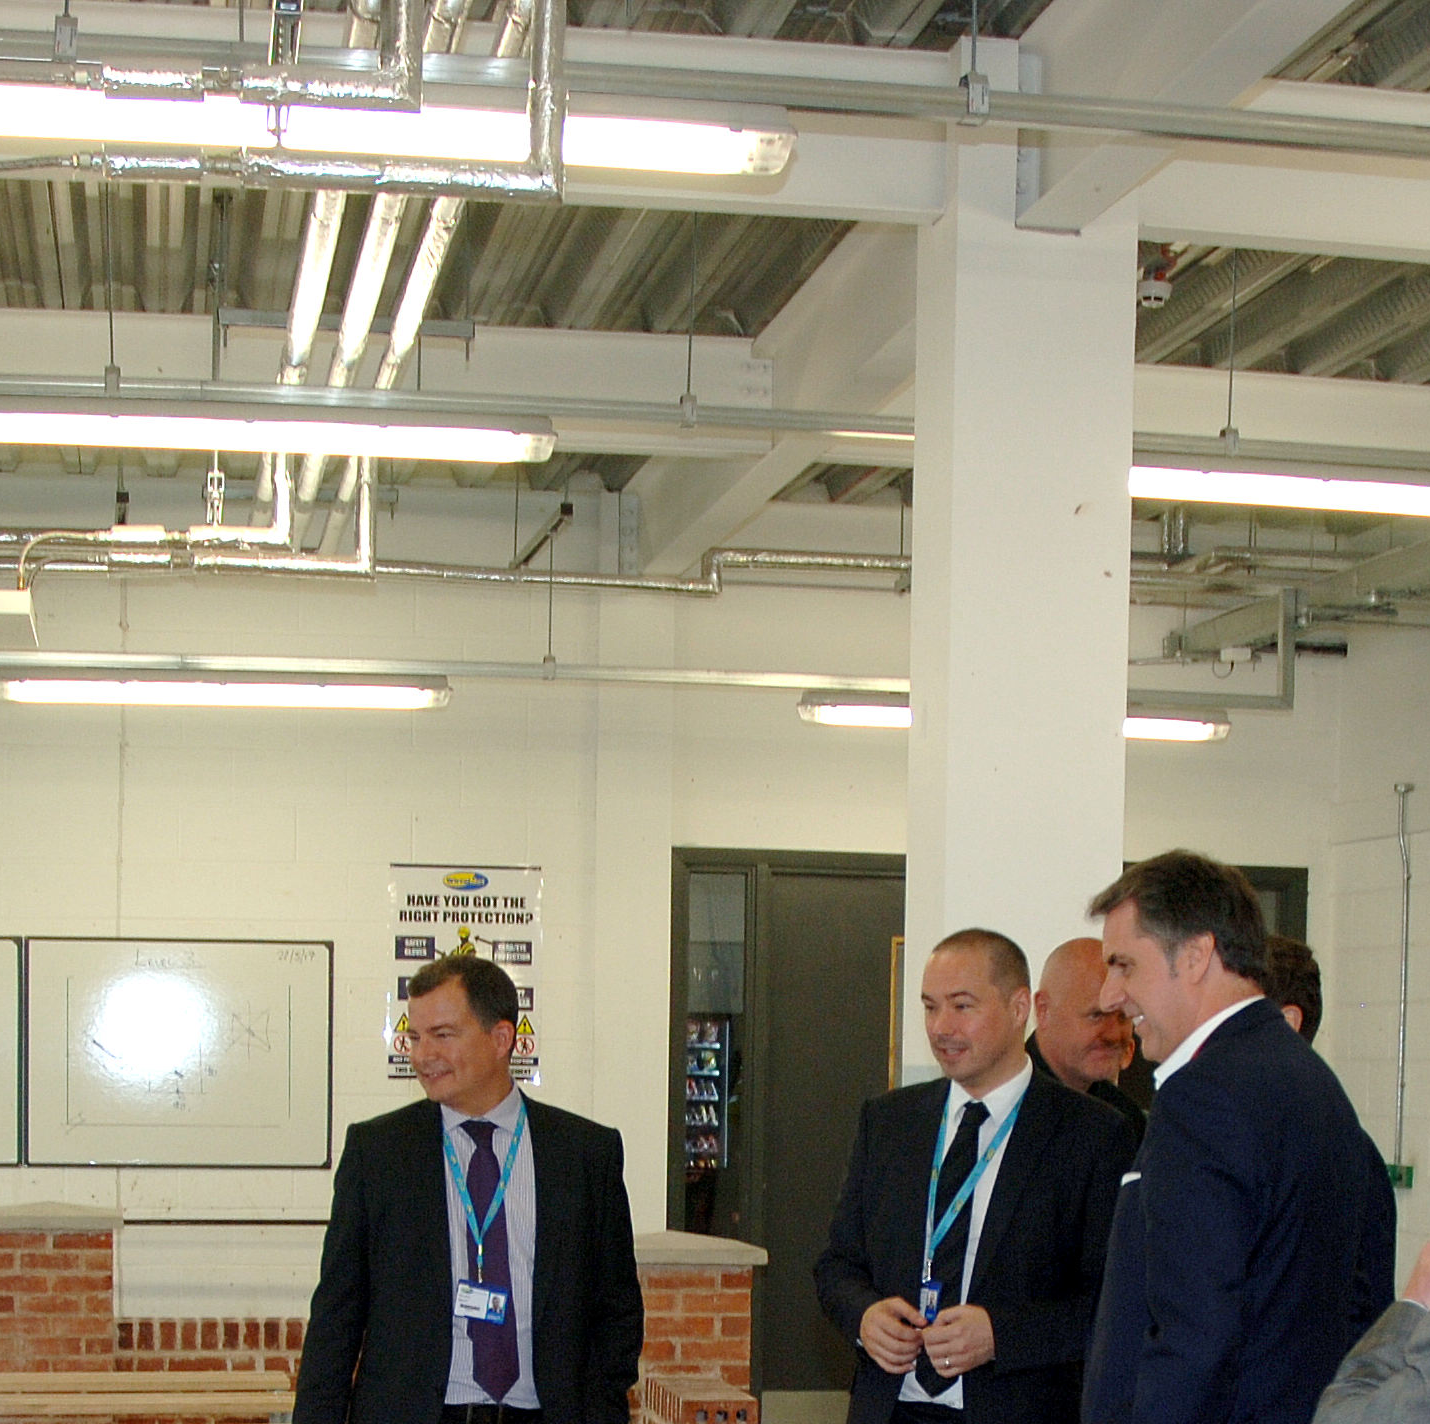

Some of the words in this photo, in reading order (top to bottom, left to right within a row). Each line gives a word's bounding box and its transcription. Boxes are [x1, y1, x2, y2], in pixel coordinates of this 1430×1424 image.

[407, 894, 439, 906] HAVE
[444, 896, 469, 907] YOU
[473, 896, 500, 908] GOT
[503, 897, 525, 908] THE
[399, 910, 439, 922] RIGHT
[443, 911, 533, 924] PROTECTION?
